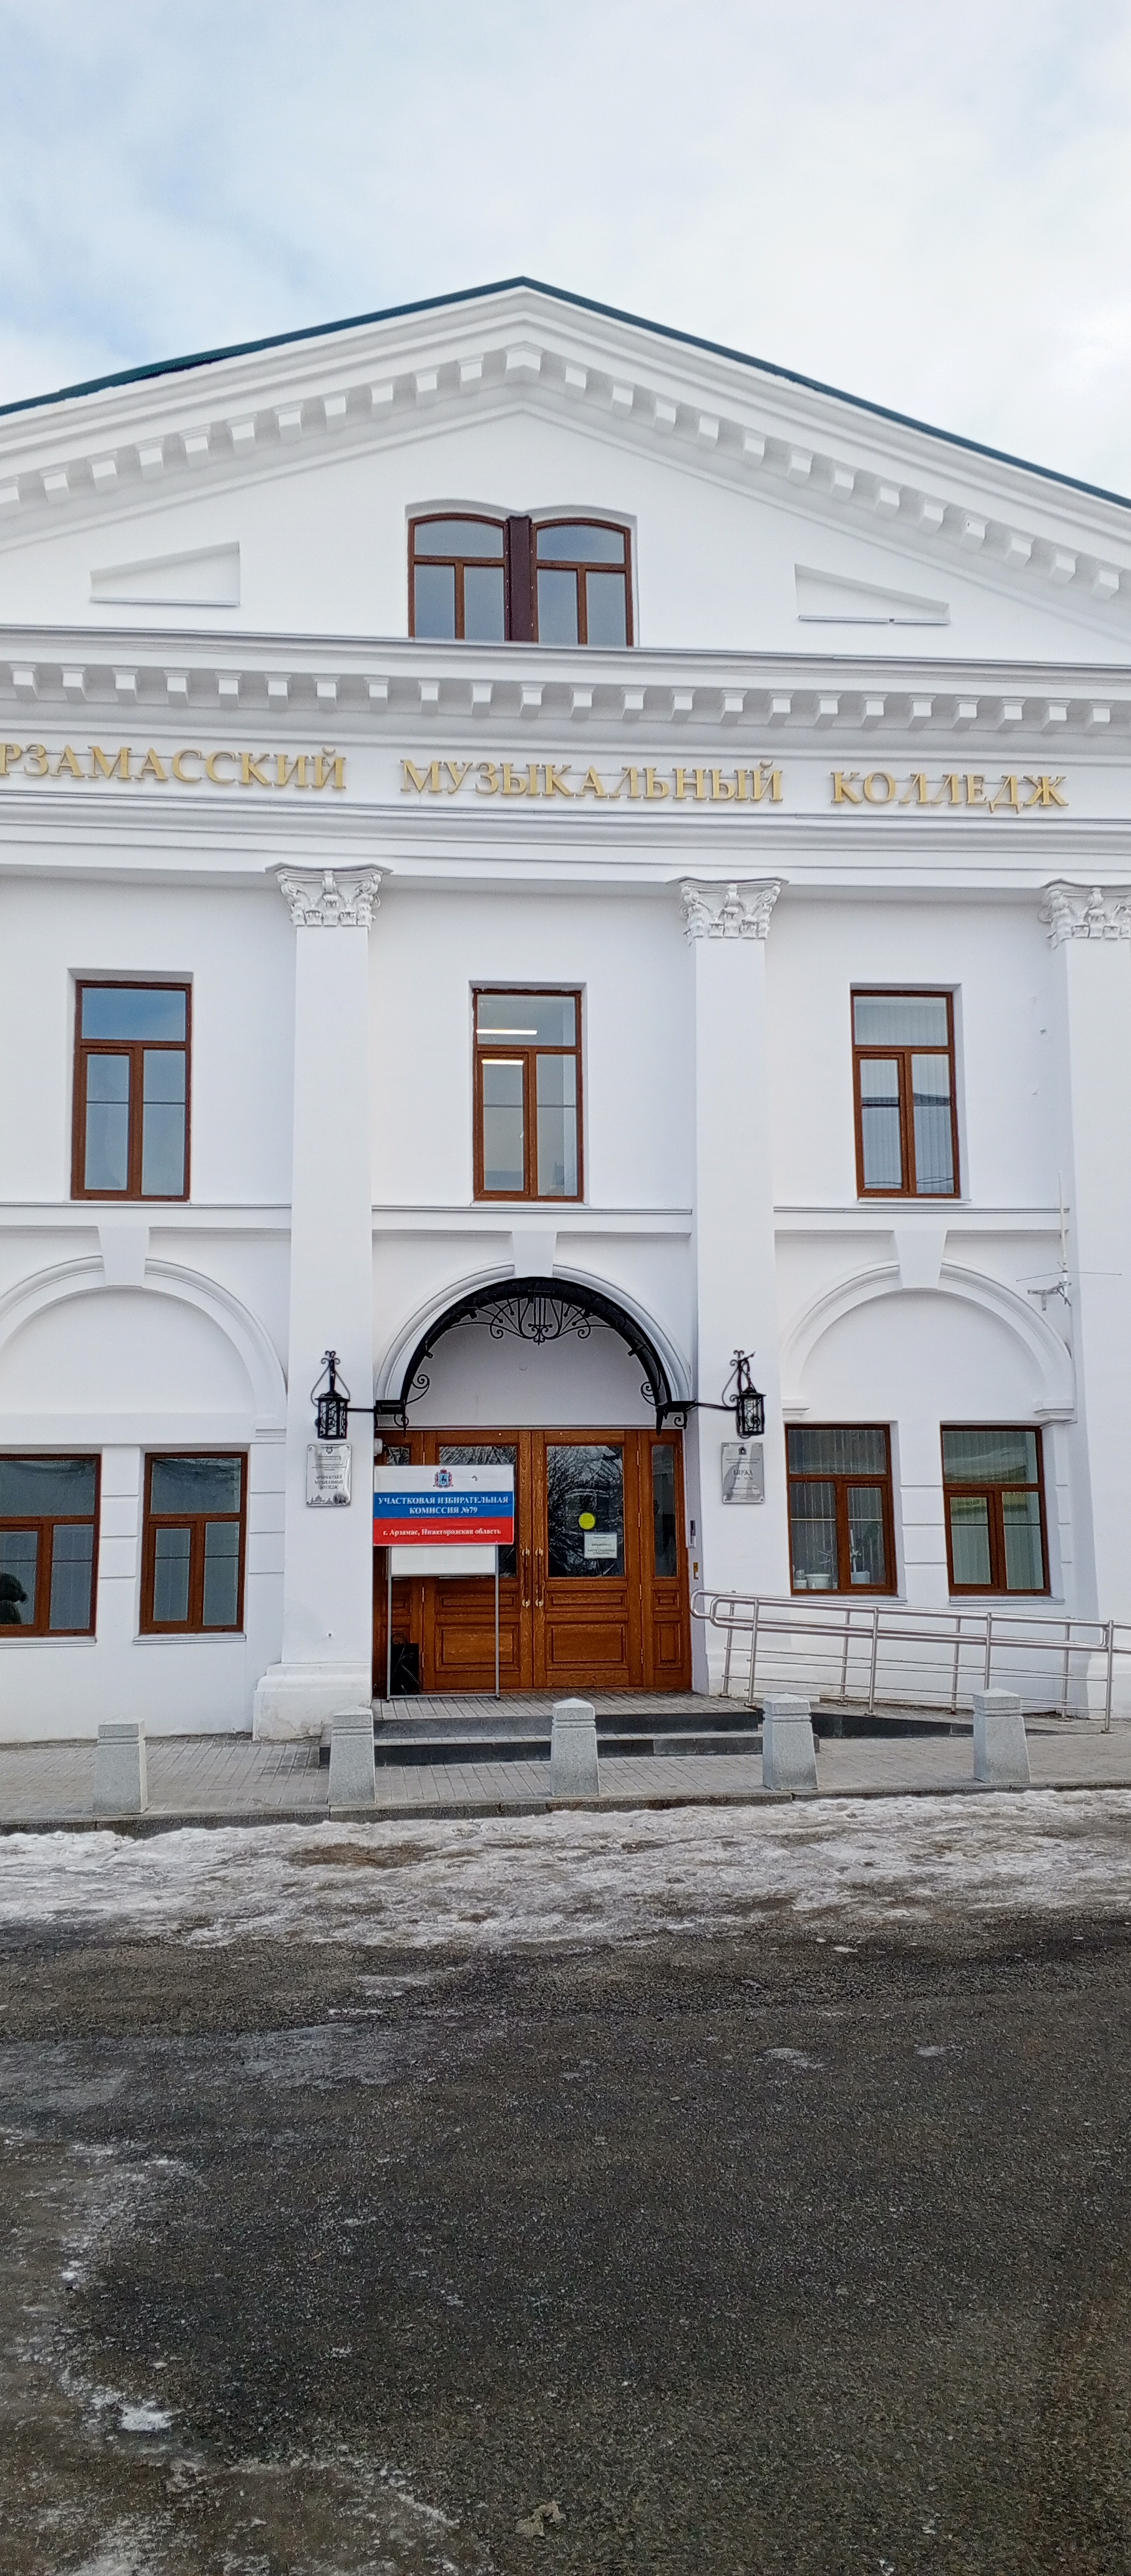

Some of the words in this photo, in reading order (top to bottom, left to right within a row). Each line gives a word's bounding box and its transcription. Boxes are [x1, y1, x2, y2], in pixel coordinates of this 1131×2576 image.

[0, 743, 346, 789] РЗАМАССКИЙ
[400, 759, 784, 802] МУЗЫКАЛЬНЫЙ
[830, 771, 1069, 814] КОЛЛЕДЖ
[389, 1529, 420, 1537] Арзамас,
[422, 1528, 473, 1537] Нижегородская
